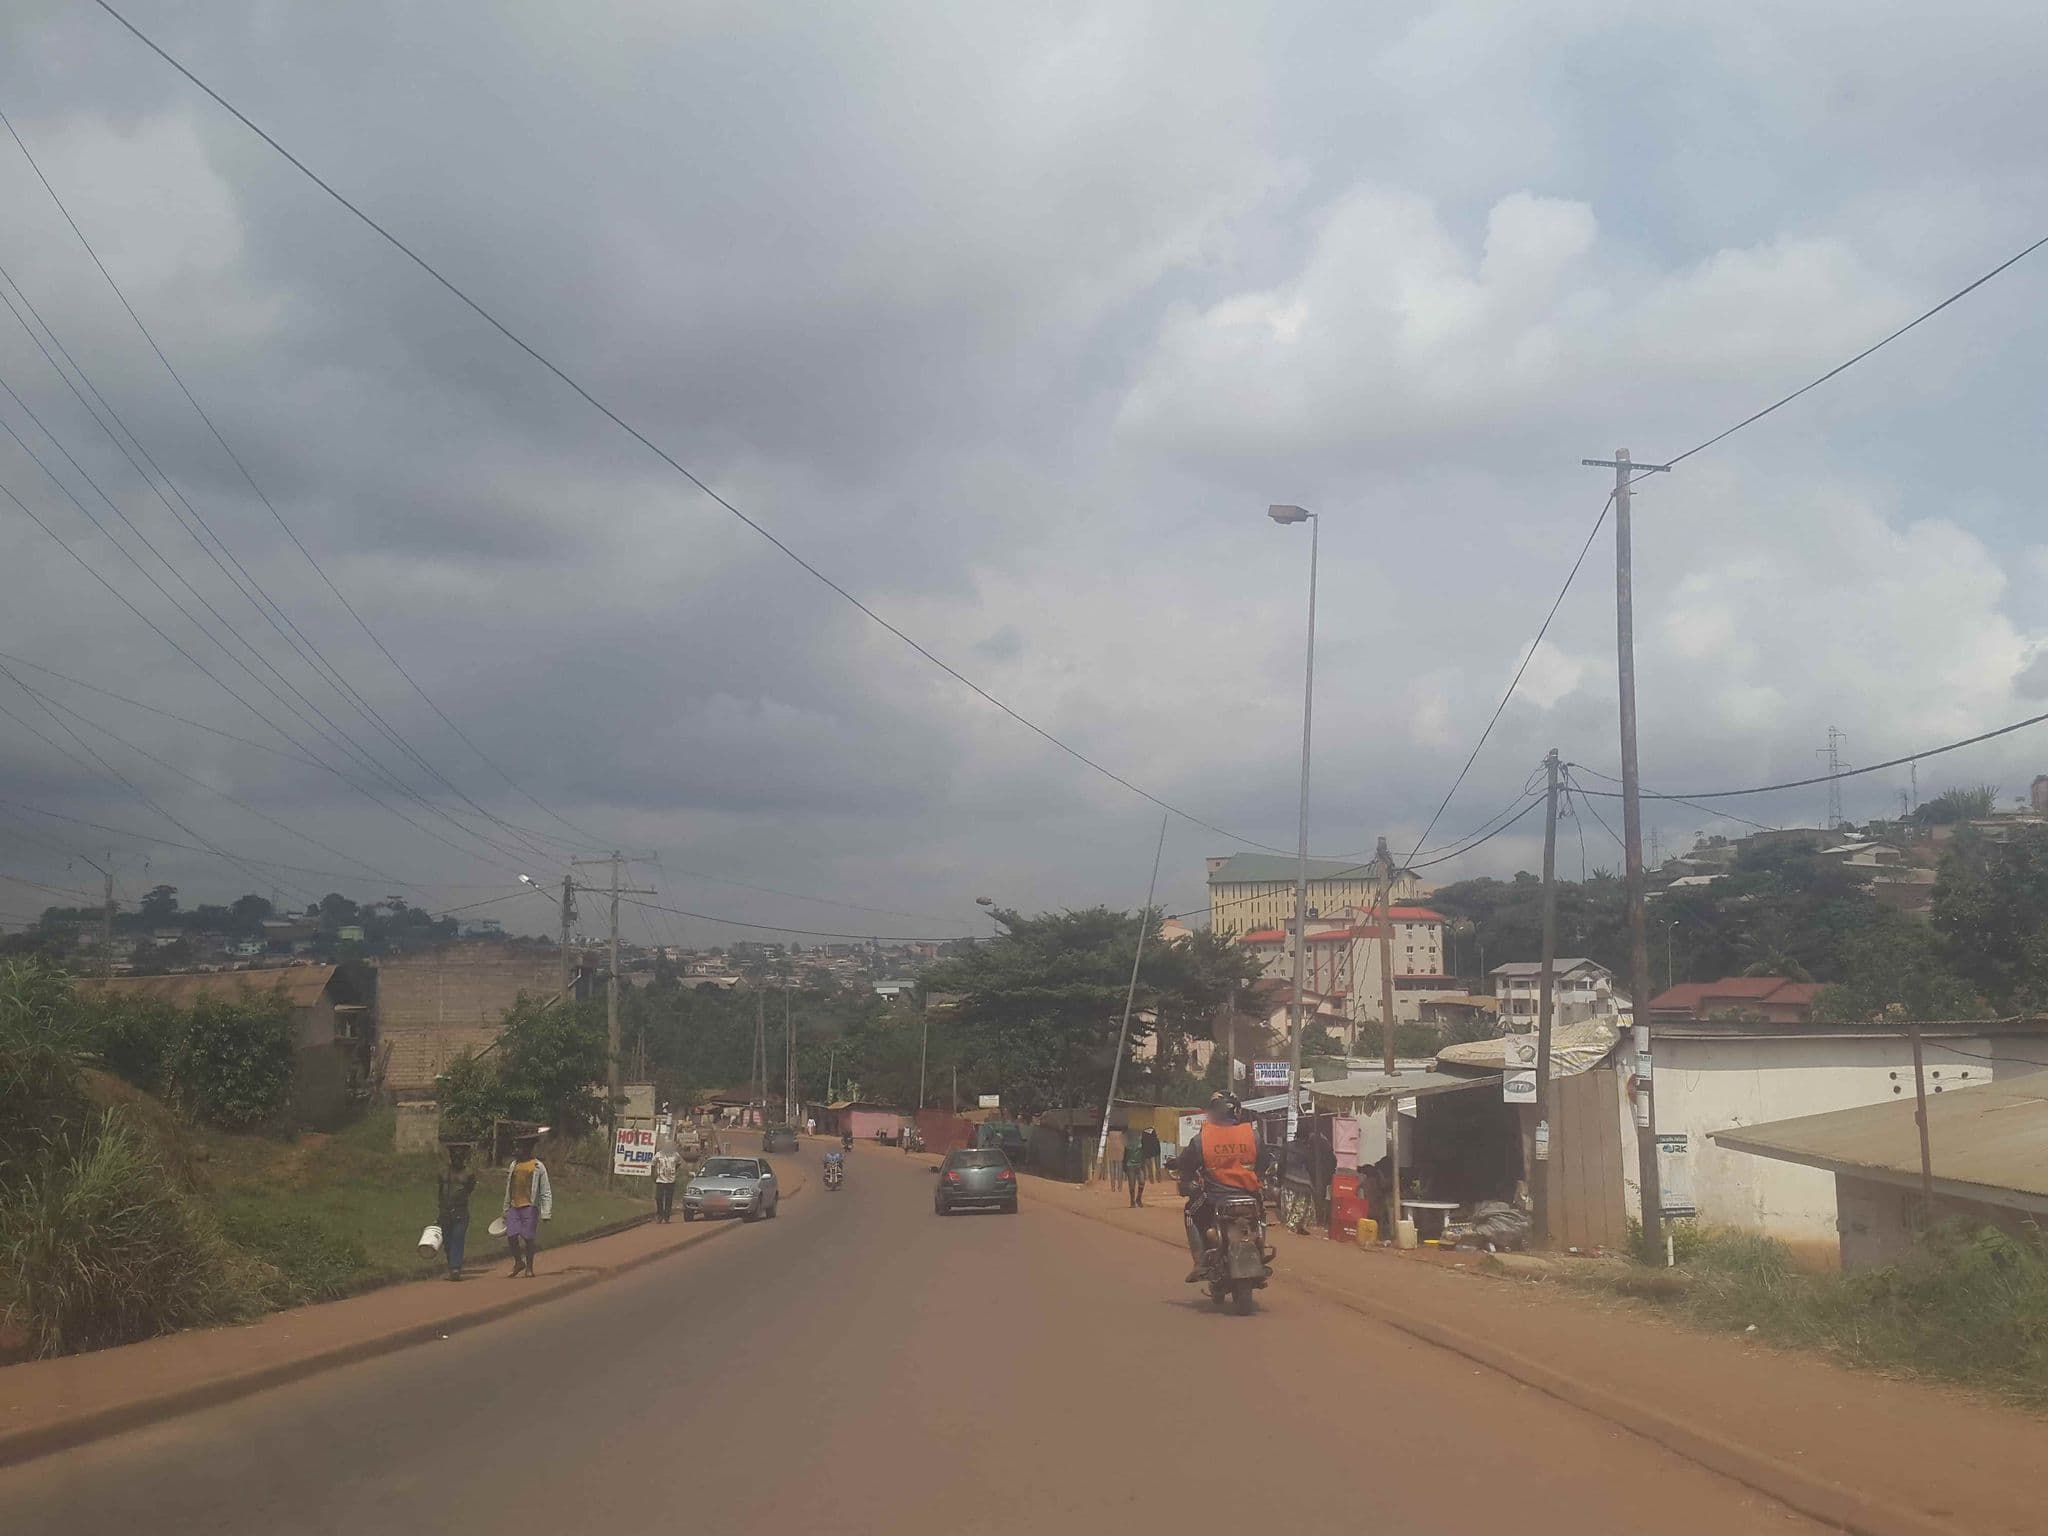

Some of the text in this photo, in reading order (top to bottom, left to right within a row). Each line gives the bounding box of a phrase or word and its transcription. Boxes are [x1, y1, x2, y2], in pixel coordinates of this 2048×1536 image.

[617, 1130, 655, 1146] HOTEL
[616, 1144, 625, 1154] LA
[624, 1150, 654, 1163] FLEUR
